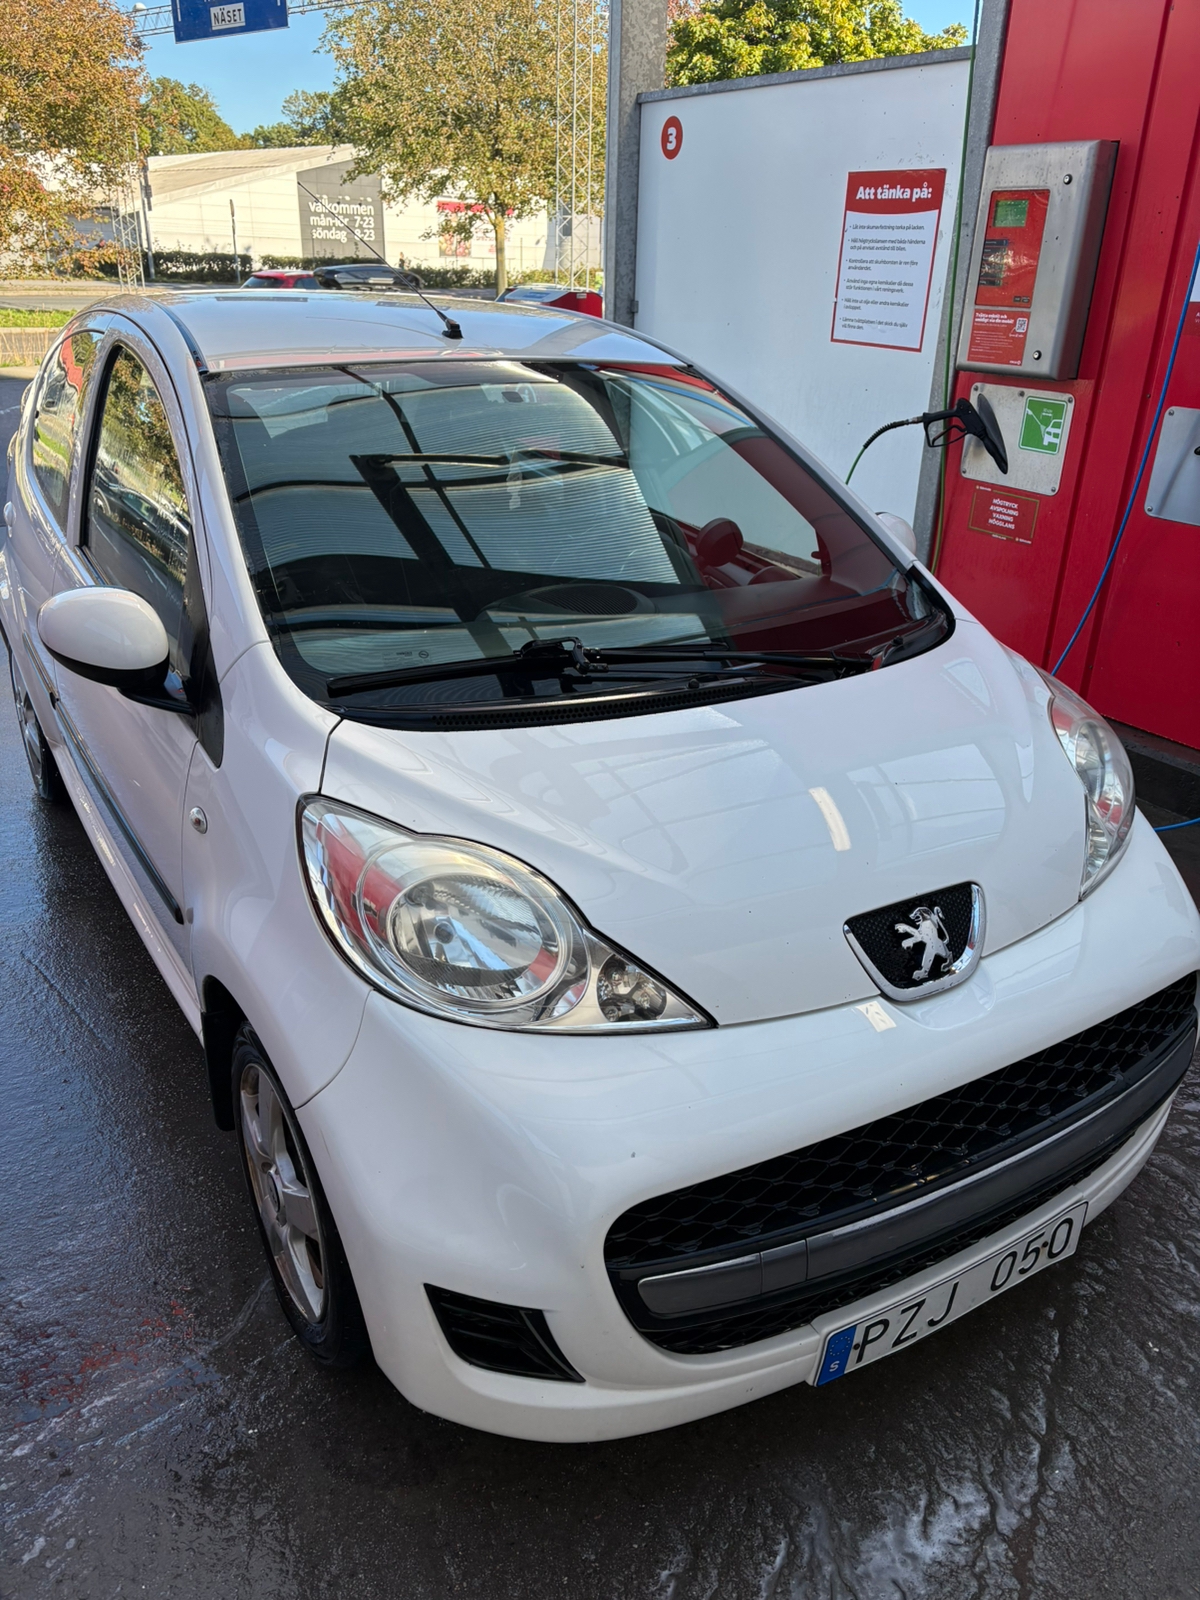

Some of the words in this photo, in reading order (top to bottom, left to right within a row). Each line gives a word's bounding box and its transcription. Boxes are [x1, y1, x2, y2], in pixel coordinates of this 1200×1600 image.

[213, 8, 242, 25] NÄSET
[666, 126, 677, 150] 3
[856, 186, 875, 200] Att
[877, 184, 911, 200] tänka
[912, 182, 932, 202] på:
[308, 198, 374, 216] välkommen
[312, 227, 347, 243] söndag
[990, 505, 1018, 516] AVSPOLNING
[992, 498, 1018, 509] HÖGTRYCK
[988, 518, 1015, 529] HÖGGLANS
[992, 513, 1013, 522] VAXNING
[855, 1280, 960, 1364] PZJ
[990, 1217, 1074, 1292] 050
[828, 1360, 840, 1372] S
